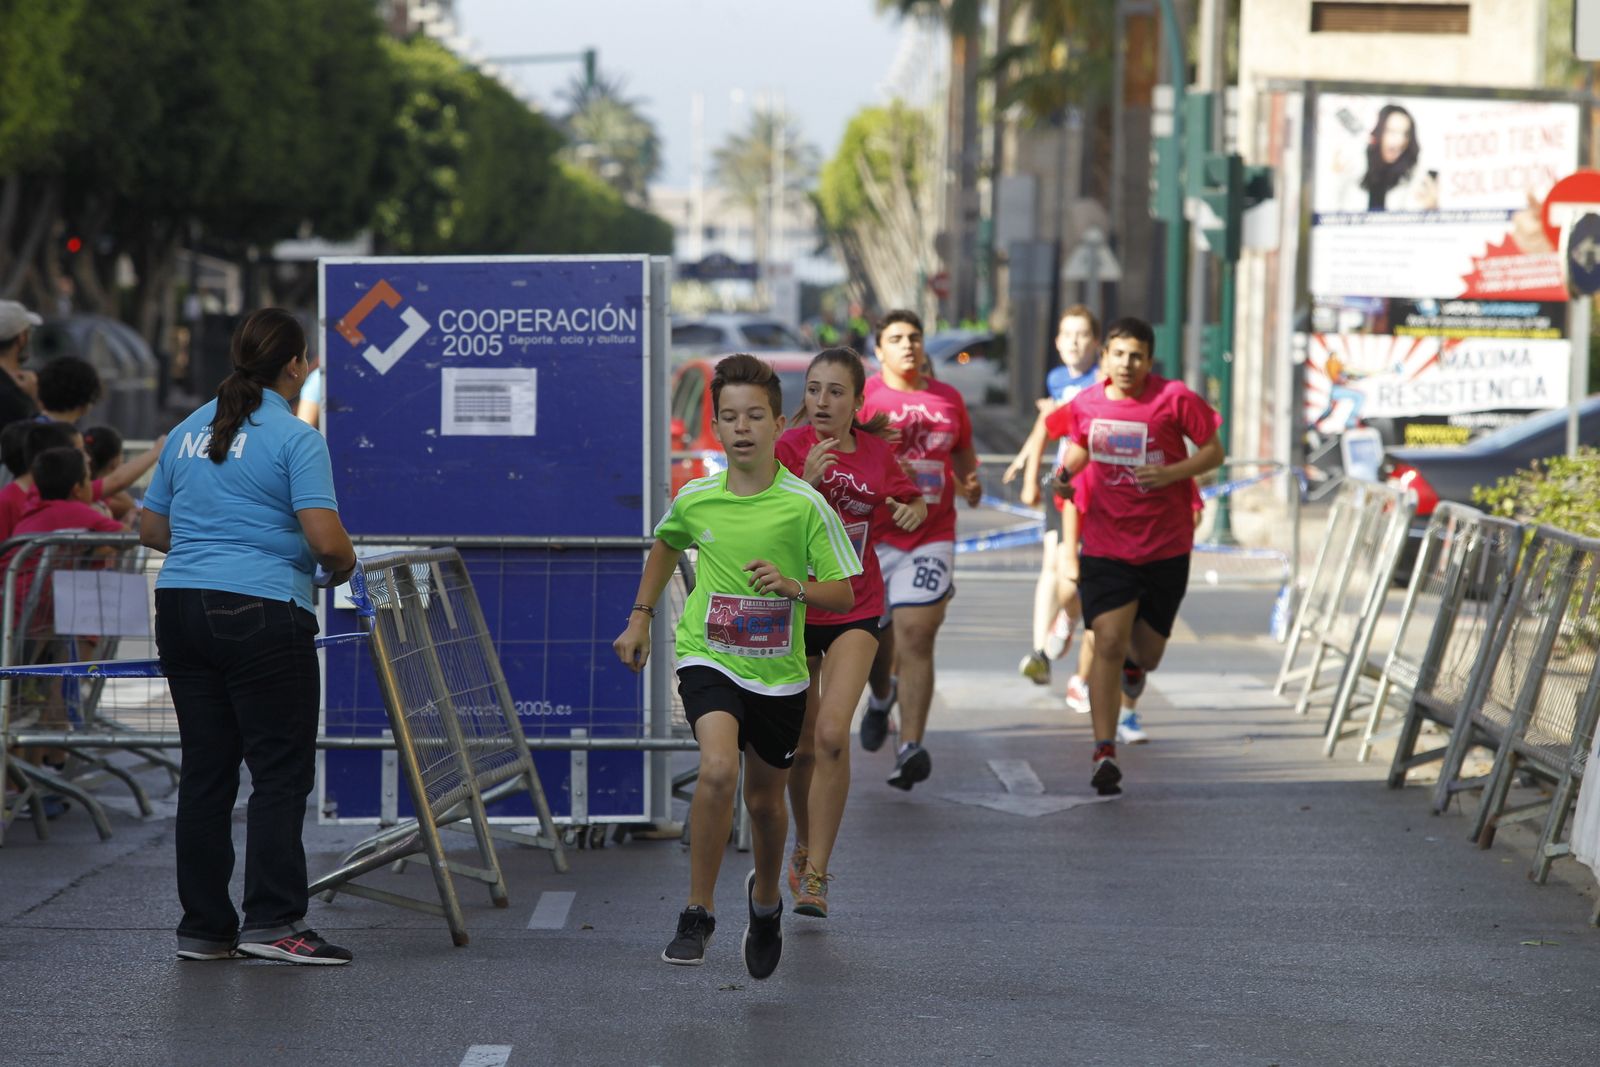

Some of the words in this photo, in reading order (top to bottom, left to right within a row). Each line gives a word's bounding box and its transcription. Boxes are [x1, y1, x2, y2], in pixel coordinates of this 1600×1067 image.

[1444, 131, 1499, 159] TODO
[438, 303, 637, 332] COOPERACIÓN
[442, 334, 503, 357] 2005
[560, 334, 584, 346] ocio
[587, 336, 594, 347] y
[597, 333, 636, 346] cultura
[1377, 376, 1548, 408] RESISTENCIA
[913, 566, 942, 592] 86
[732, 615, 786, 634] 1621
